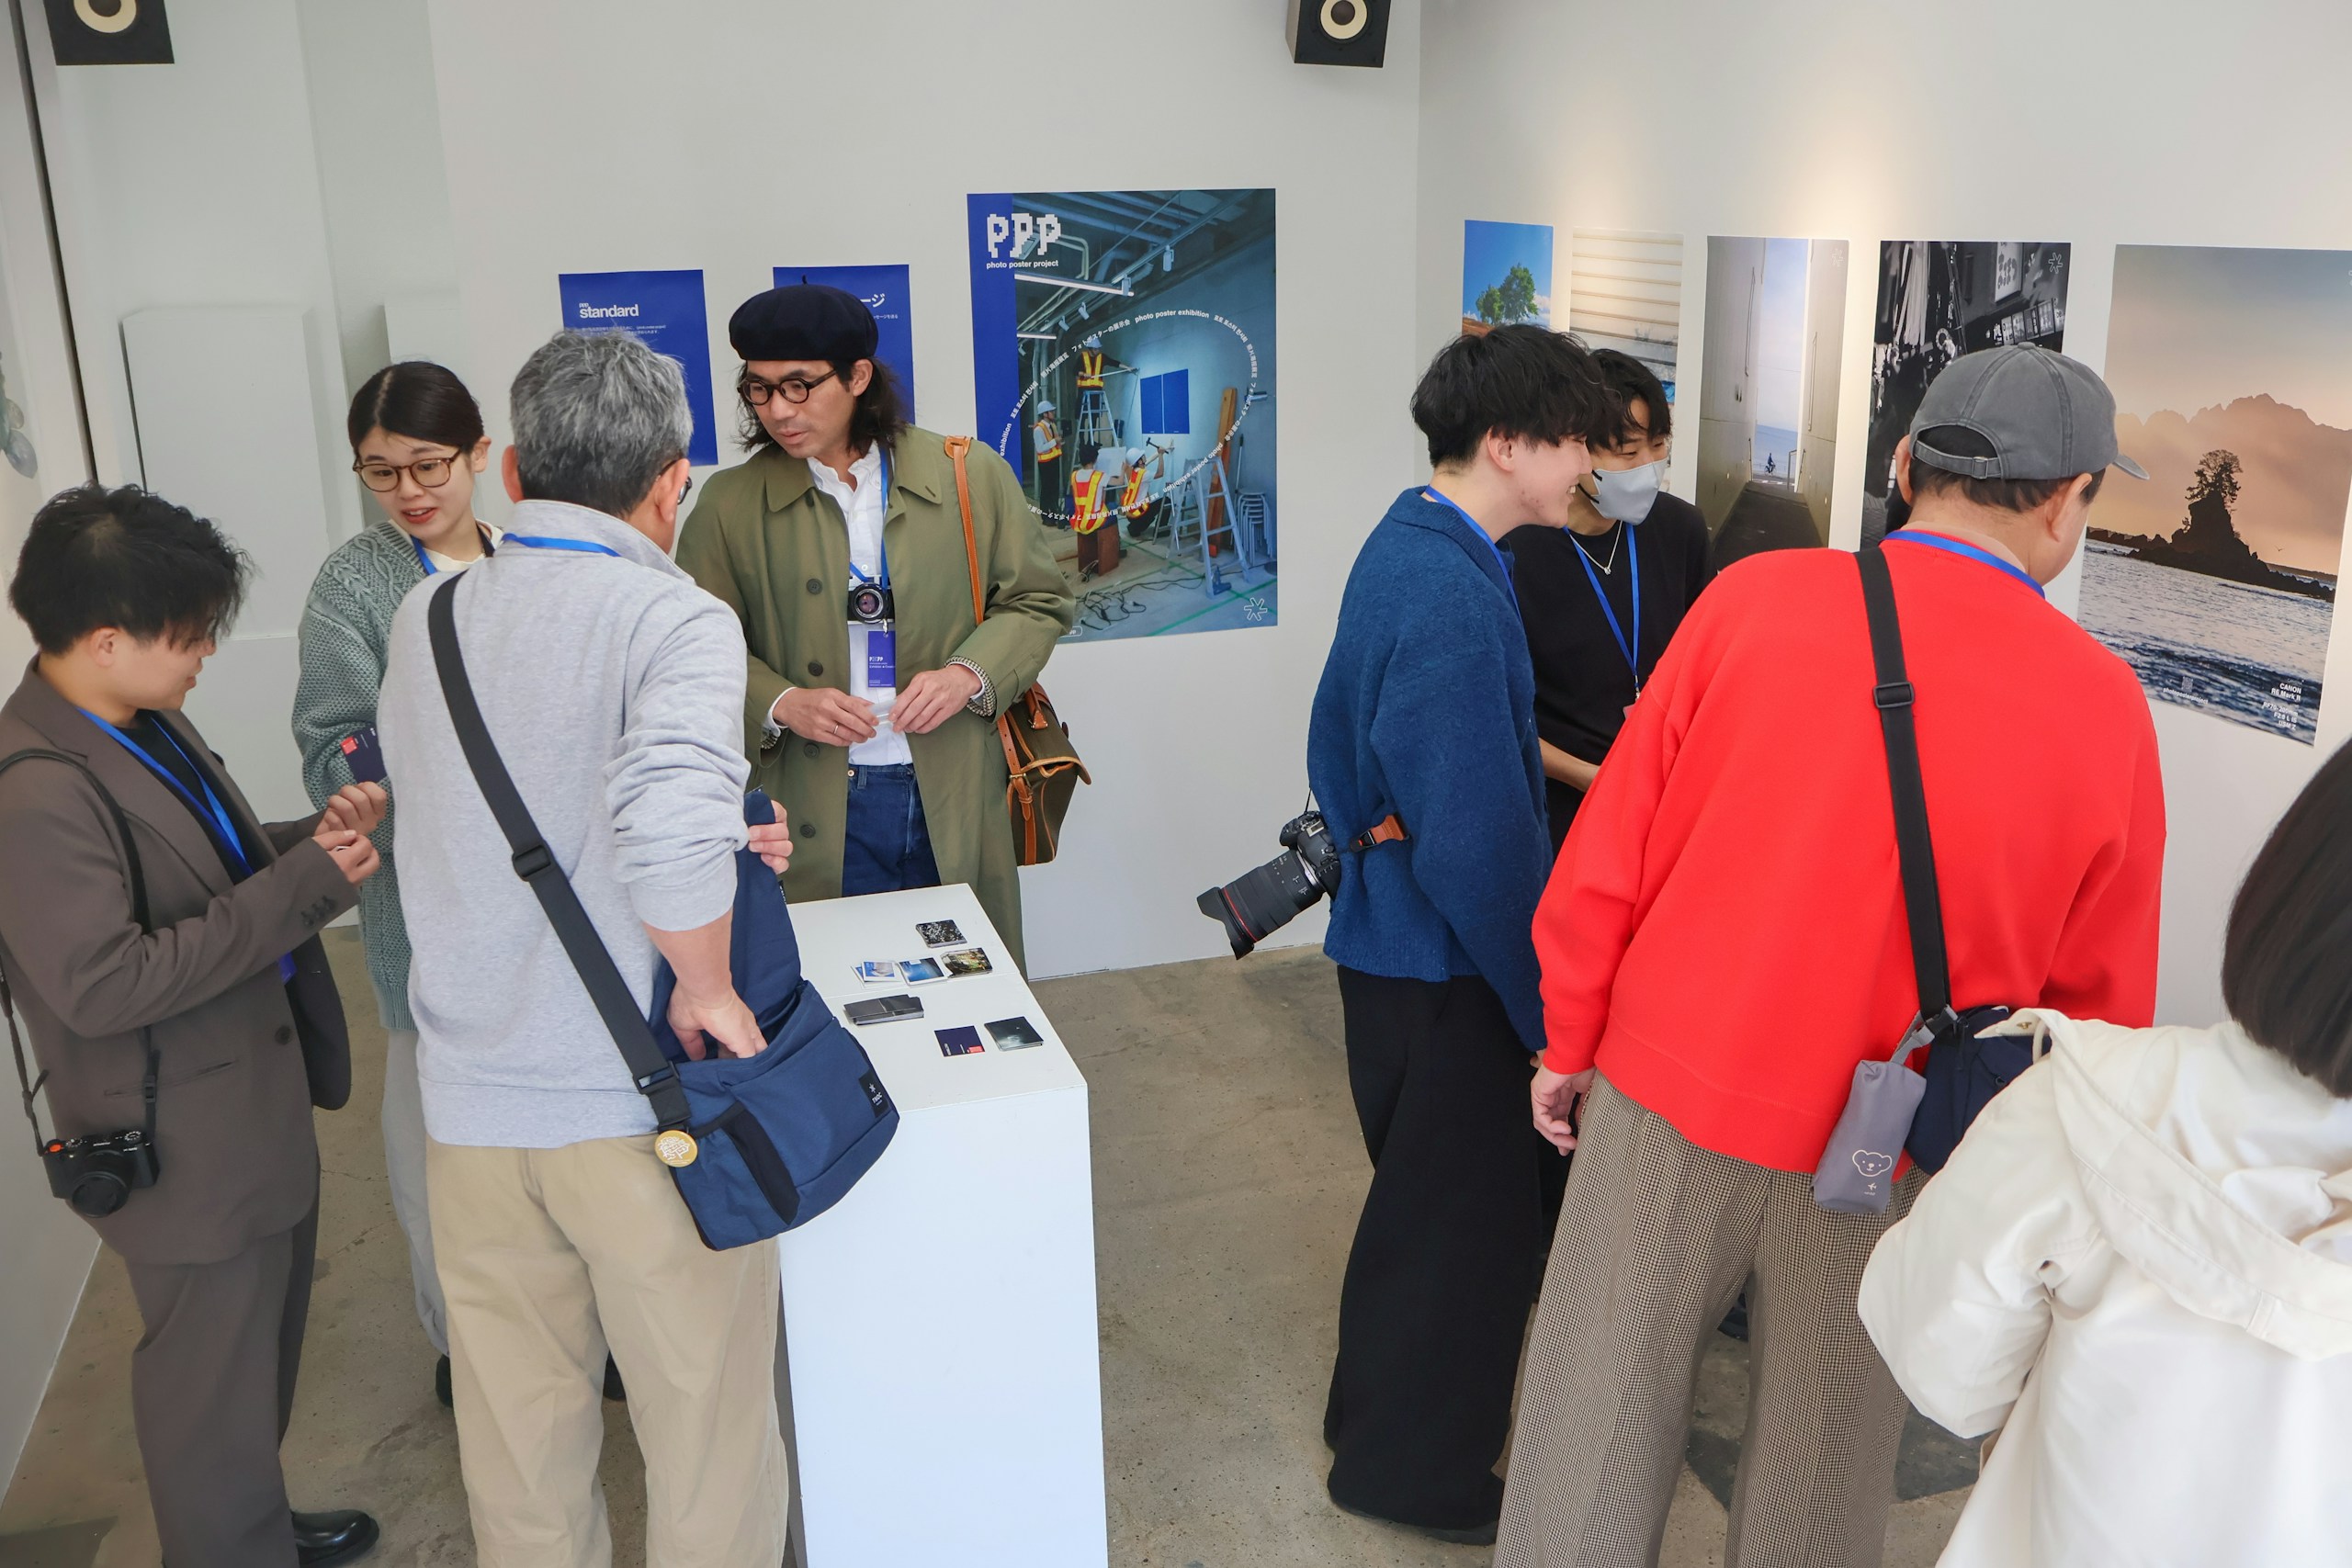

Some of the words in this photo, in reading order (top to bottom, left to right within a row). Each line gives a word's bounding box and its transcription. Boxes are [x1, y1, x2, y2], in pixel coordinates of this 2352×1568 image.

[986, 262, 1008, 270] photo
[1009, 261, 1032, 269] poster
[1034, 260, 1059, 268] project
[580, 304, 639, 319] standard
[1135, 313, 1154, 324] photo
[1155, 310, 1177, 319] poster
[1178, 309, 1210, 319] exhibition
[1000, 423, 1012, 457] exhibition
[1208, 442, 1224, 459] photo
[1191, 457, 1208, 474] poster
[1162, 472, 1191, 493] exhibition
[2279, 682, 2302, 694] CANON
[2280, 691, 2295, 700] Mark
